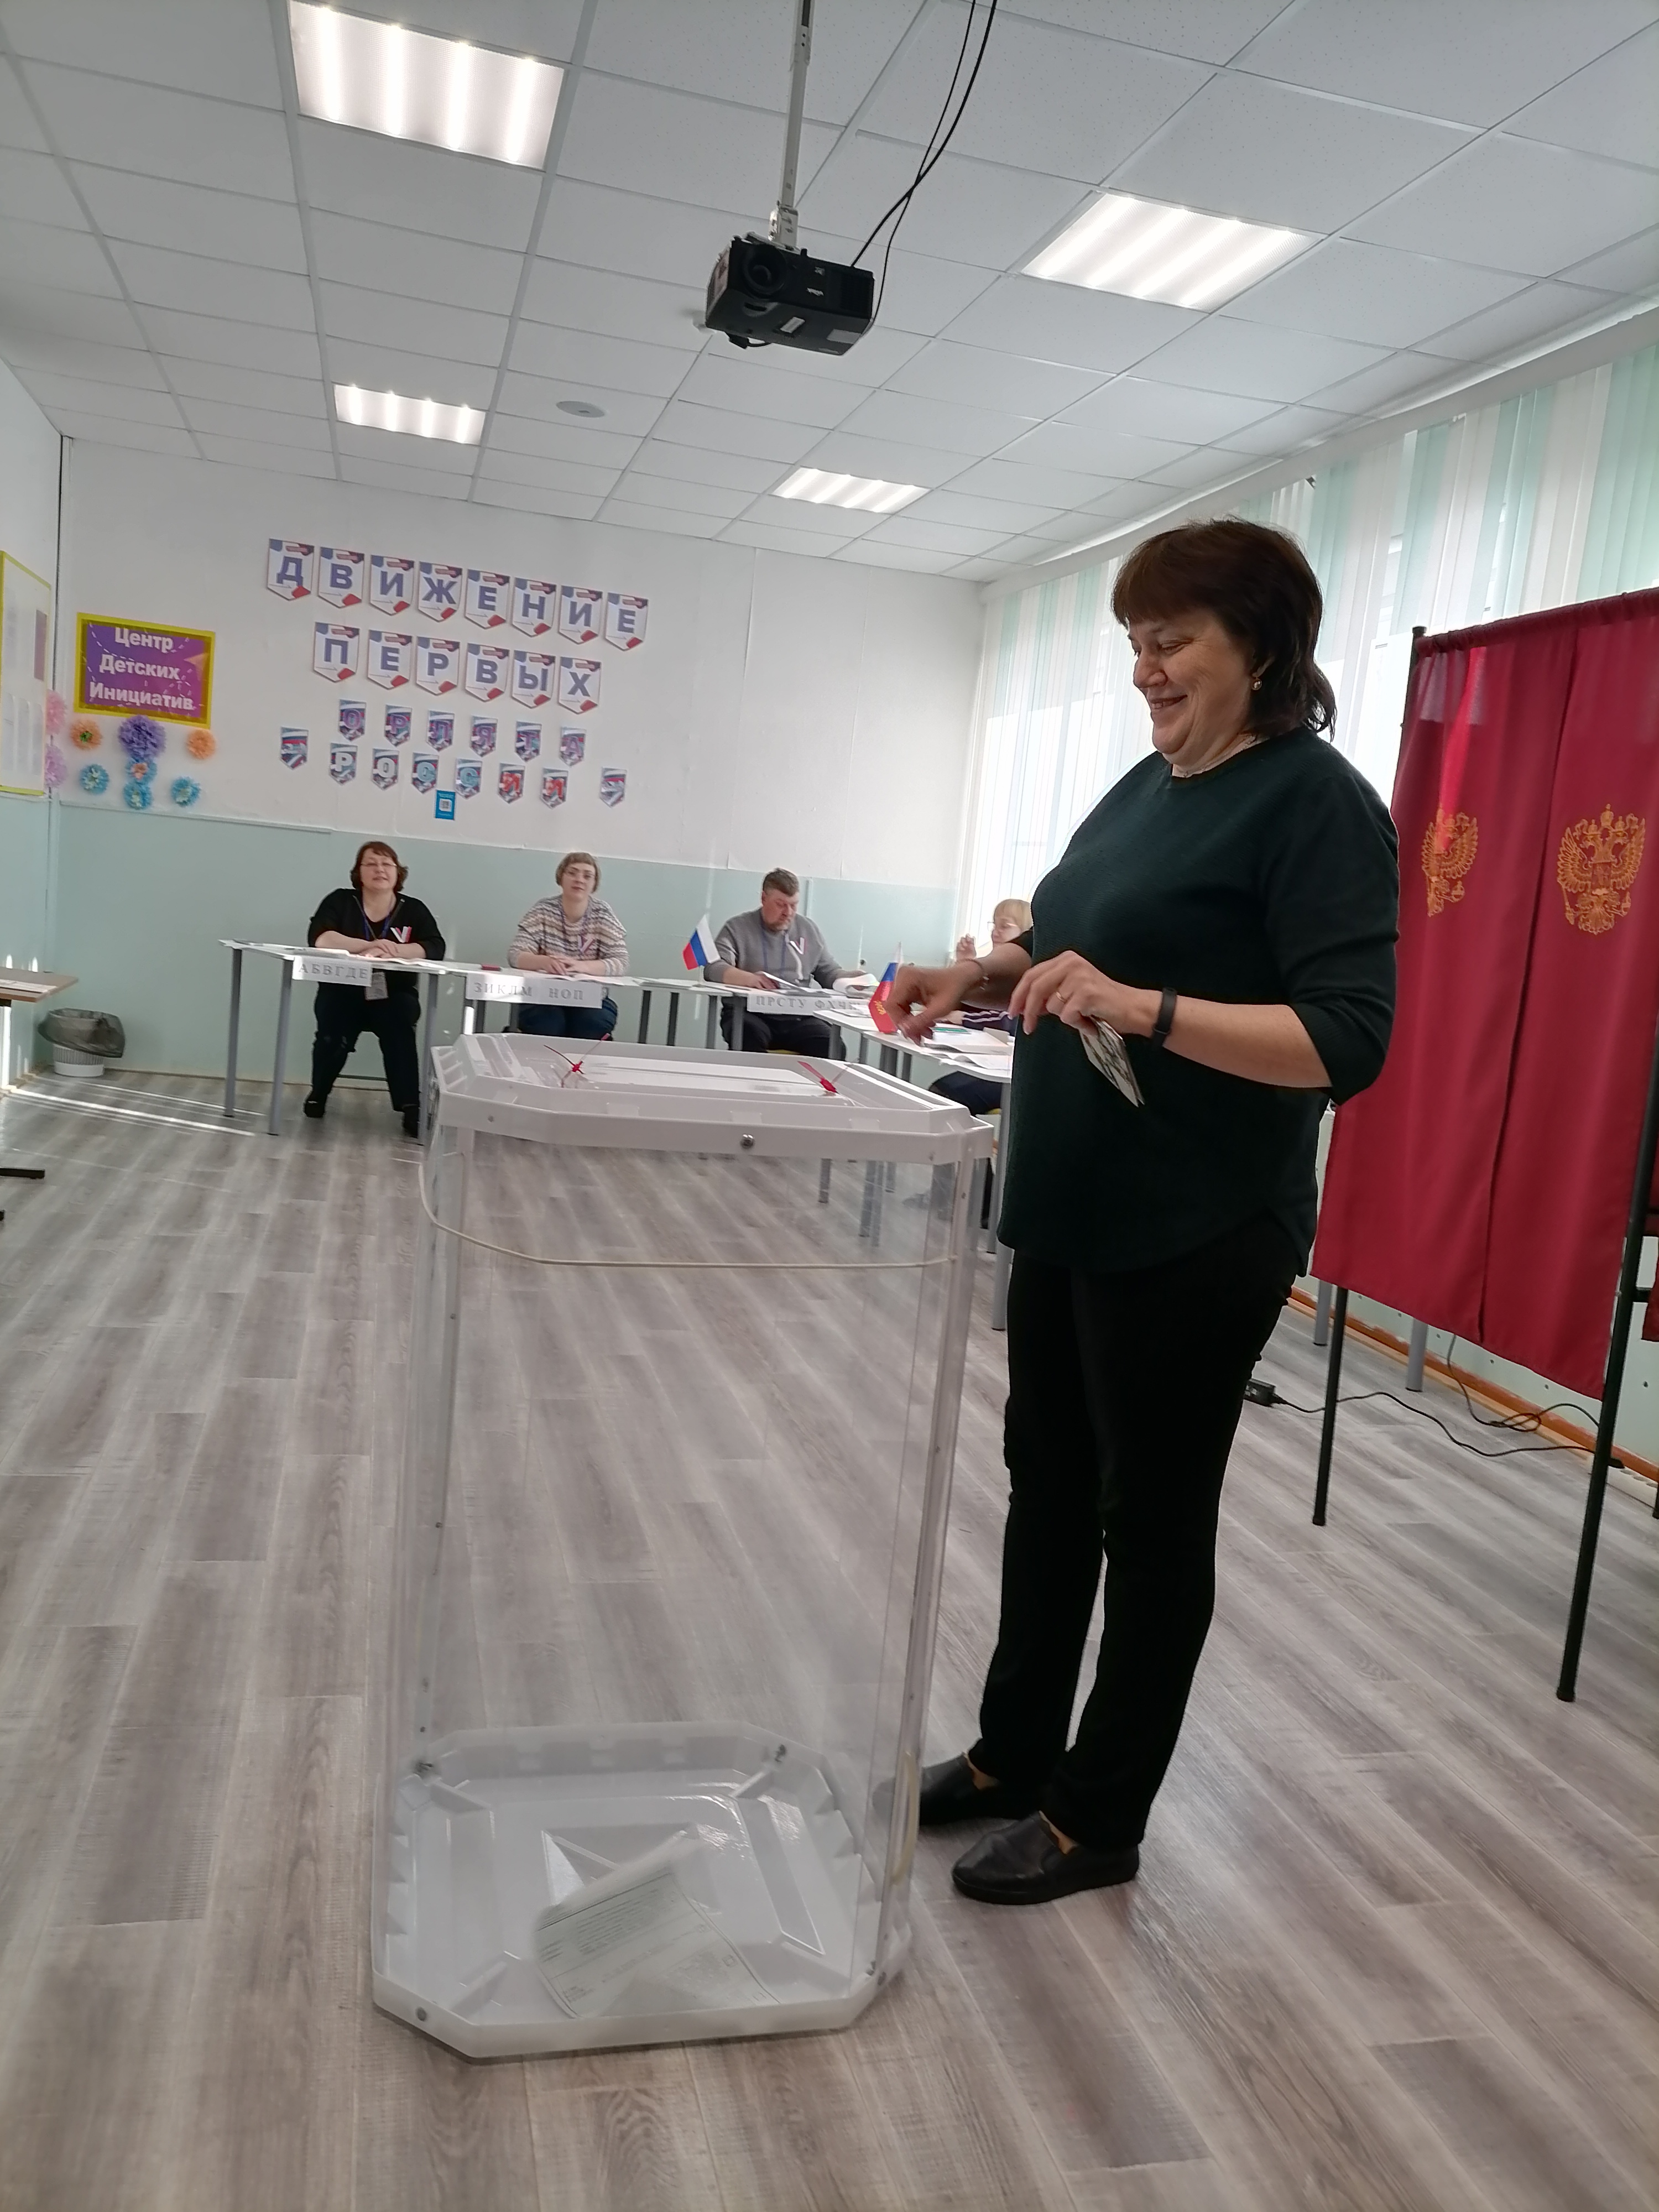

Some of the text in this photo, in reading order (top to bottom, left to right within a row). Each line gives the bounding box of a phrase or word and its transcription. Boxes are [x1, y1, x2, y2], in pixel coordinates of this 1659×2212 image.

[276, 556, 637, 634] ДВИЖЕНИЕ
[114, 627, 173, 653] Центр
[99, 654, 181, 680] Детских
[324, 638, 591, 697] ПЕРВЫХ
[89, 681, 194, 710] Инициатив
[343, 708, 580, 756] ОРЛЯТА
[335, 752, 564, 797] РОССИИ
[299, 963, 368, 979] АБВГДЕ
[549, 987, 583, 1000] НОП
